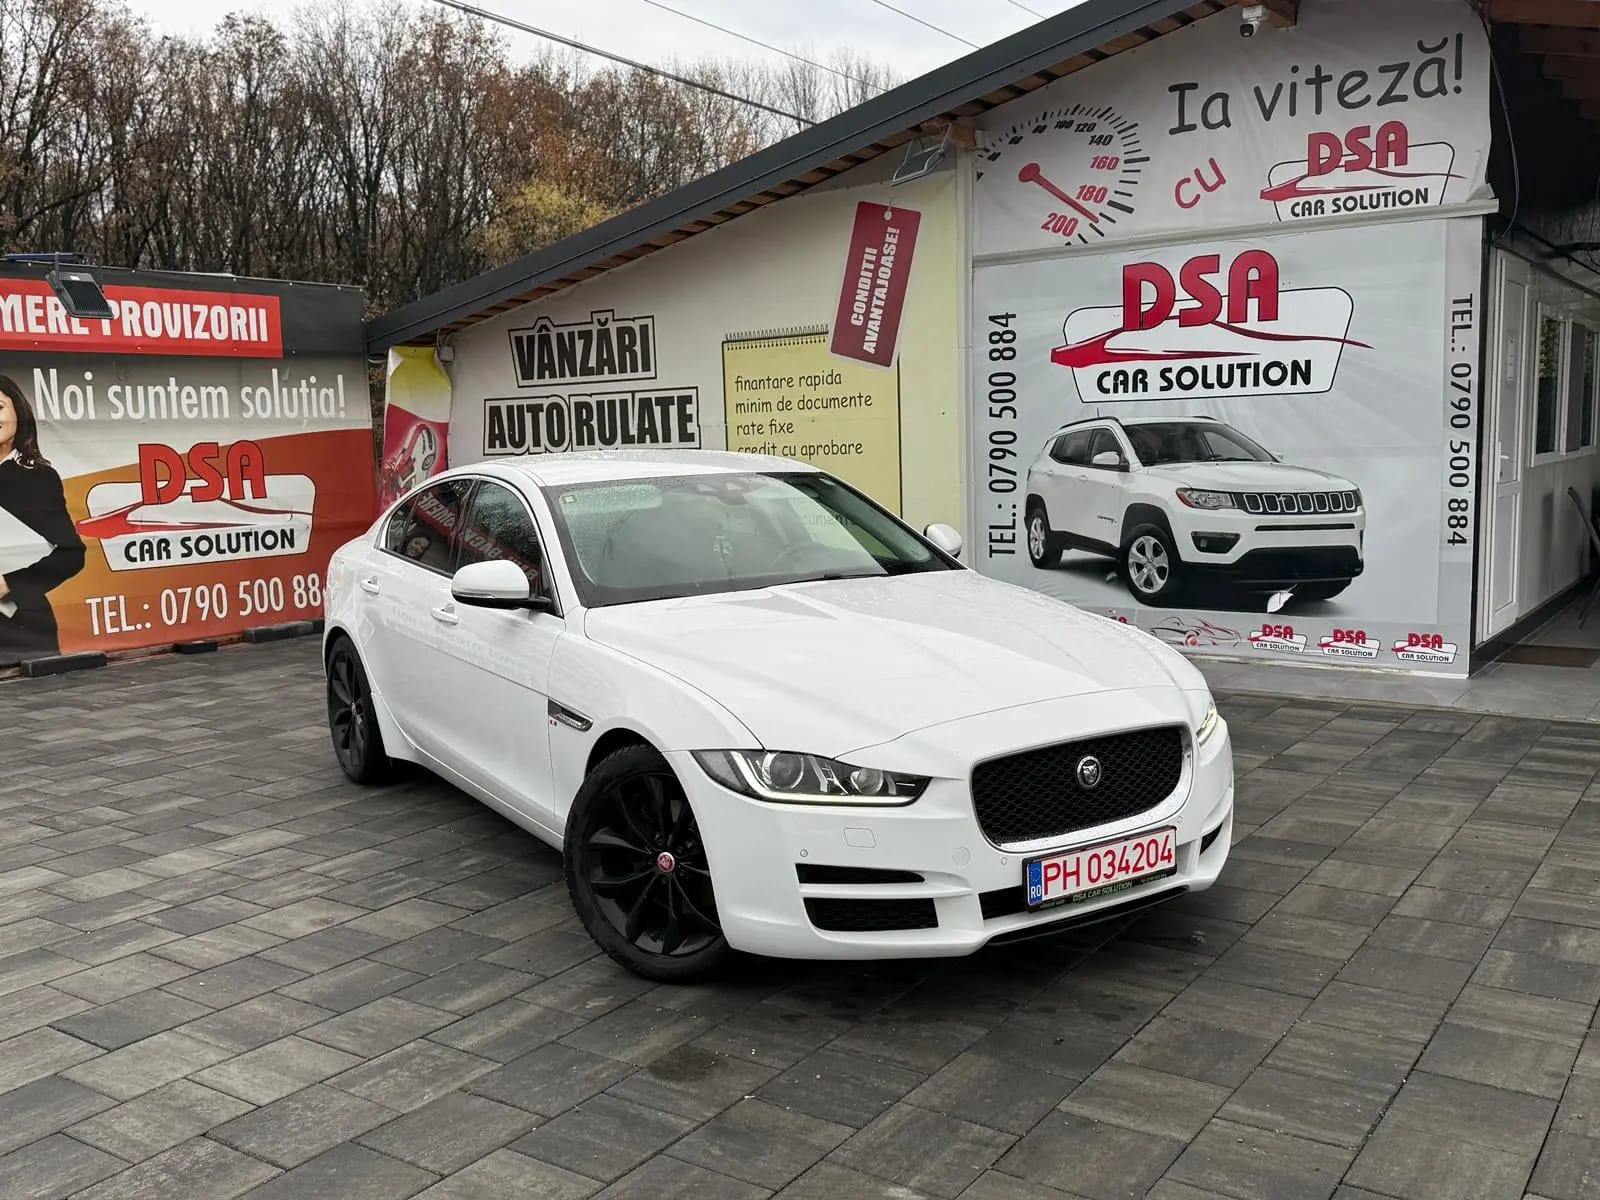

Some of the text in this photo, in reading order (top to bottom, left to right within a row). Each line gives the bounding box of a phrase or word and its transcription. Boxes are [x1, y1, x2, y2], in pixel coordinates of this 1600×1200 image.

[1168, 33, 1463, 136] Ia viteză!
[1074, 122, 1096, 133] 120
[1088, 134, 1113, 146] 140
[1089, 155, 1120, 170] 160
[1307, 120, 1408, 176] DSA
[1075, 184, 1108, 203] 180
[1174, 157, 1227, 209] cu
[1290, 187, 1429, 217] CAR SOLUTION
[1041, 212, 1078, 237] 200
[851, 247, 877, 326] CONDITII
[863, 226, 900, 354] AVANTAJOASE!
[1122, 249, 1279, 331] DSA
[101, 299, 269, 342] PROVIZORII
[514, 317, 652, 380] VÂNZĂRI
[33, 368, 94, 420] Noi
[107, 377, 230, 420] suntem
[734, 369, 842, 392] finantare rapida
[1096, 359, 1312, 395] CAR SOLUTION
[735, 392, 873, 414] minim de documente
[1447, 293, 1473, 546] TEL.: 0790 500 884
[487, 395, 696, 450] AUTO RULATE
[736, 418, 794, 436] rate fixe
[988, 312, 1017, 558] TEL.: 0790 500 884
[782, 445, 796, 456] cu
[801, 440, 864, 461] aprobare
[138, 440, 267, 505] DSA
[124, 528, 295, 563] CAR SOLUTION
[85, 572, 326, 636] TEL.: 0790 500 88
[1262, 624, 1294, 640] DSA
[1269, 643, 1300, 652] SOLUTION
[1333, 628, 1367, 645] DSA
[1407, 633, 1443, 649] DSA
[1341, 649, 1373, 657] SOLUTION
[1416, 654, 1450, 662] SOLUTION
[1031, 835, 1173, 899] RO PH 034204
